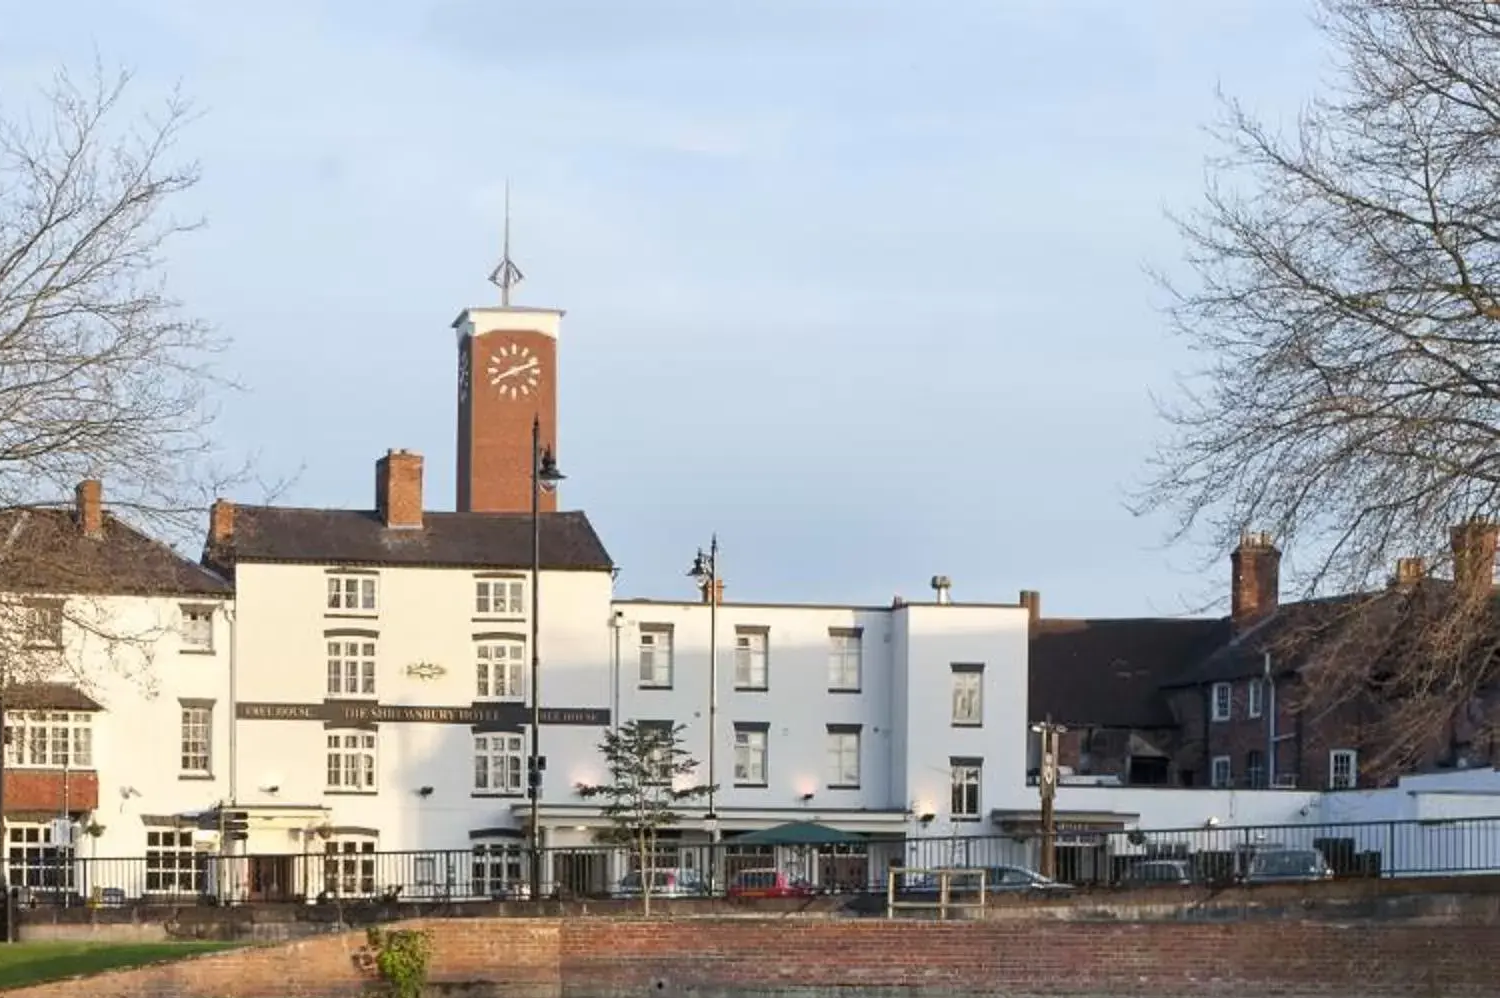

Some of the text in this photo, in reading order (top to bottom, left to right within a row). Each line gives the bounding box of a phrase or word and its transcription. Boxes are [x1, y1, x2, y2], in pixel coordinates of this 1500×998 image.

[344, 706, 500, 721] THE SHREWSBURY HOTEL
